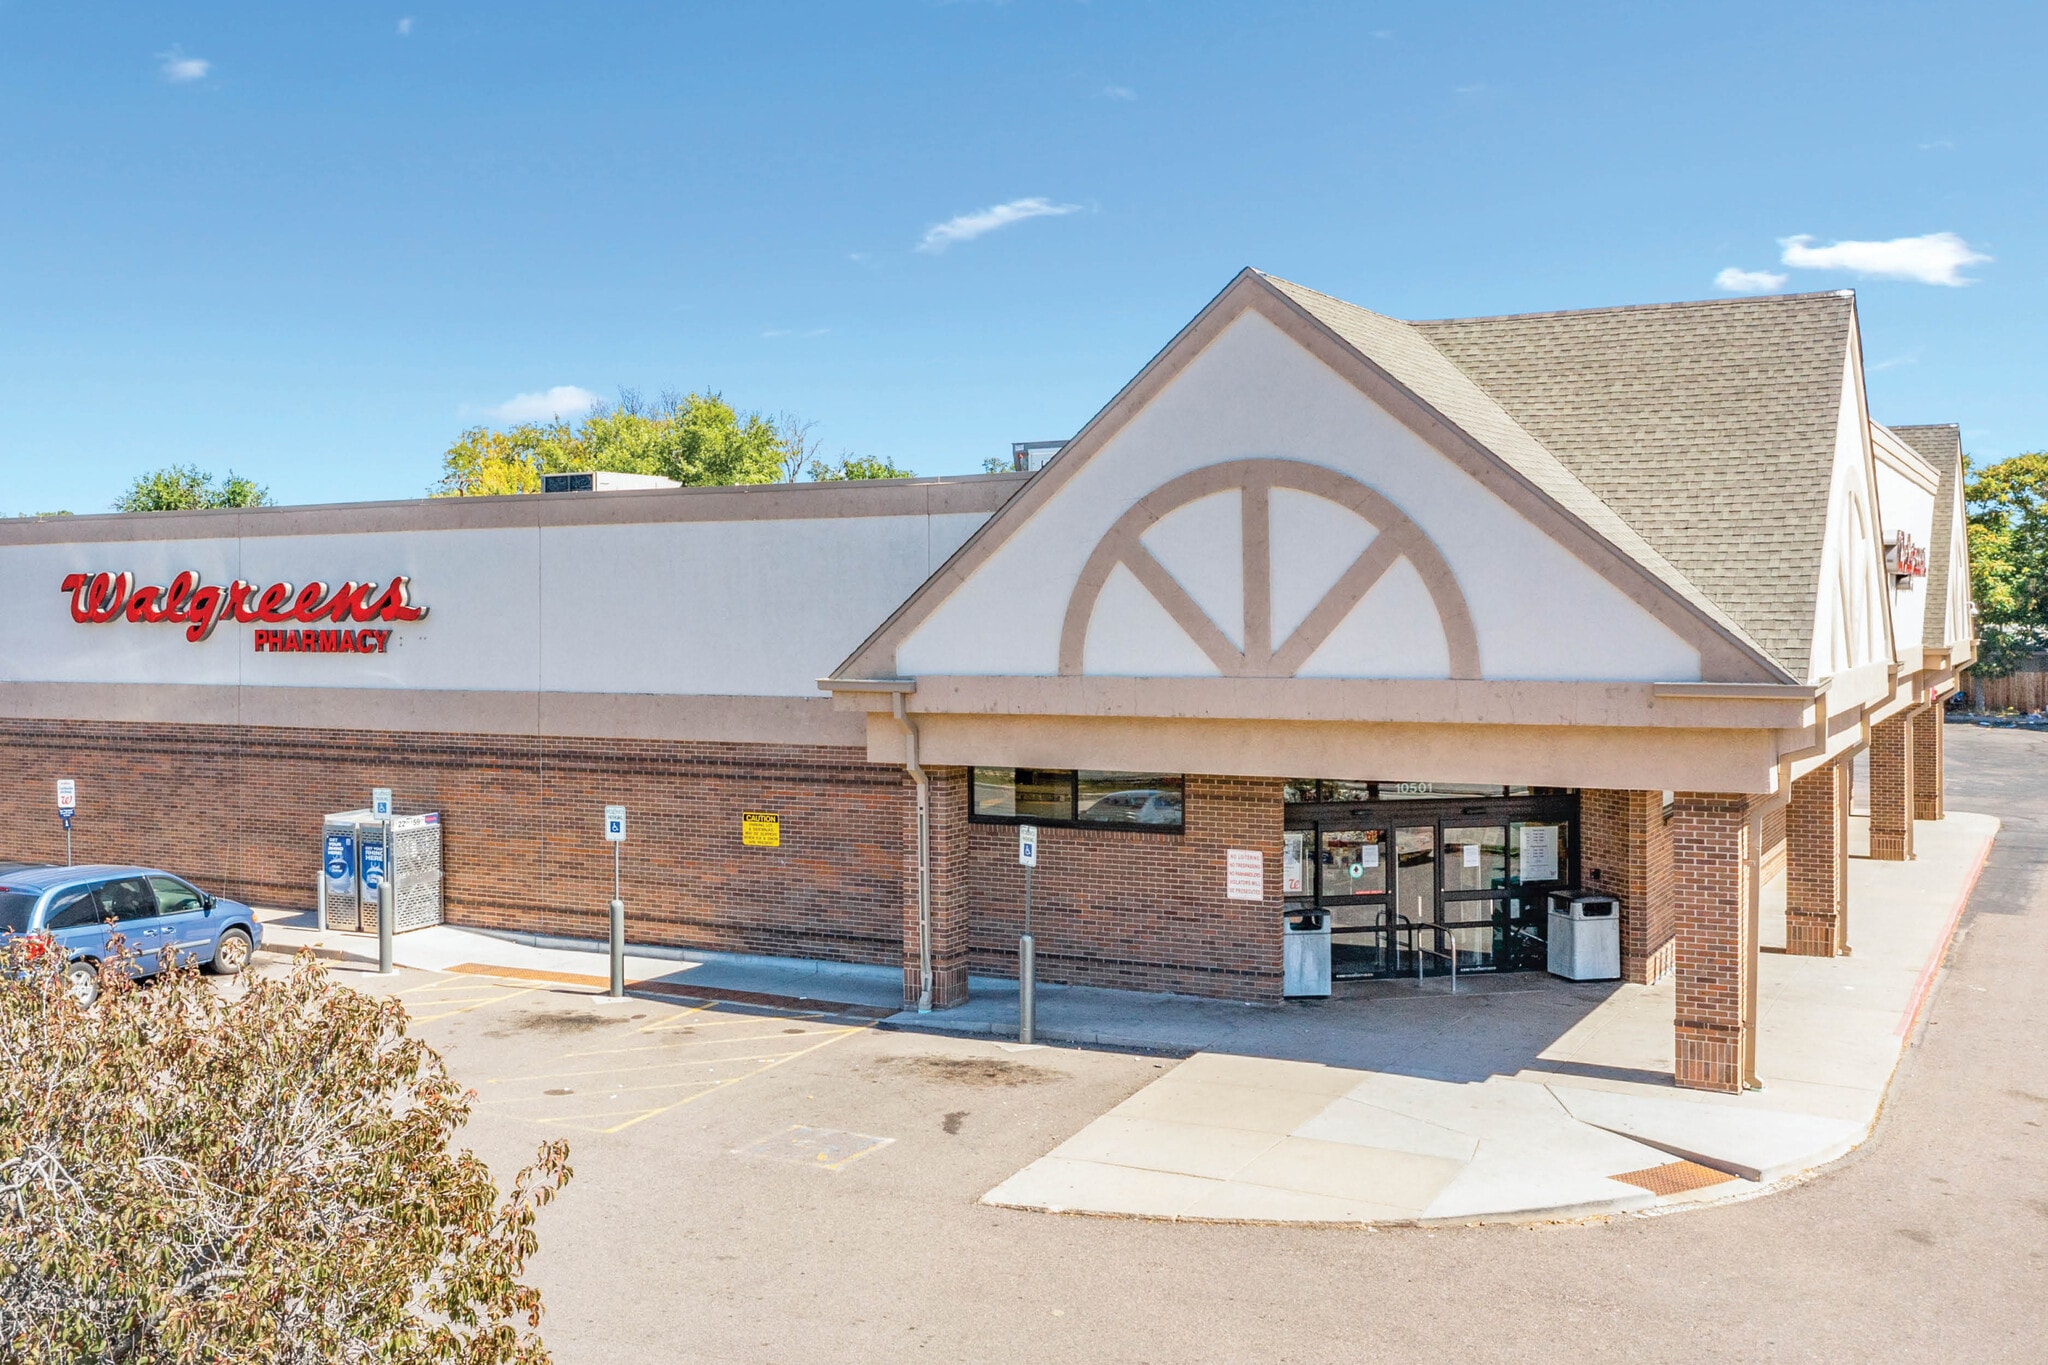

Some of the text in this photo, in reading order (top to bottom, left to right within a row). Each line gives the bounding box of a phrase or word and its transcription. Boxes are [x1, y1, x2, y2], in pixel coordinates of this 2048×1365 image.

[61, 570, 429, 642] Walgreens
[254, 629, 392, 653] PHARMACY
[1396, 783, 1433, 794] 10501
[746, 814, 776, 823] CAUTION
